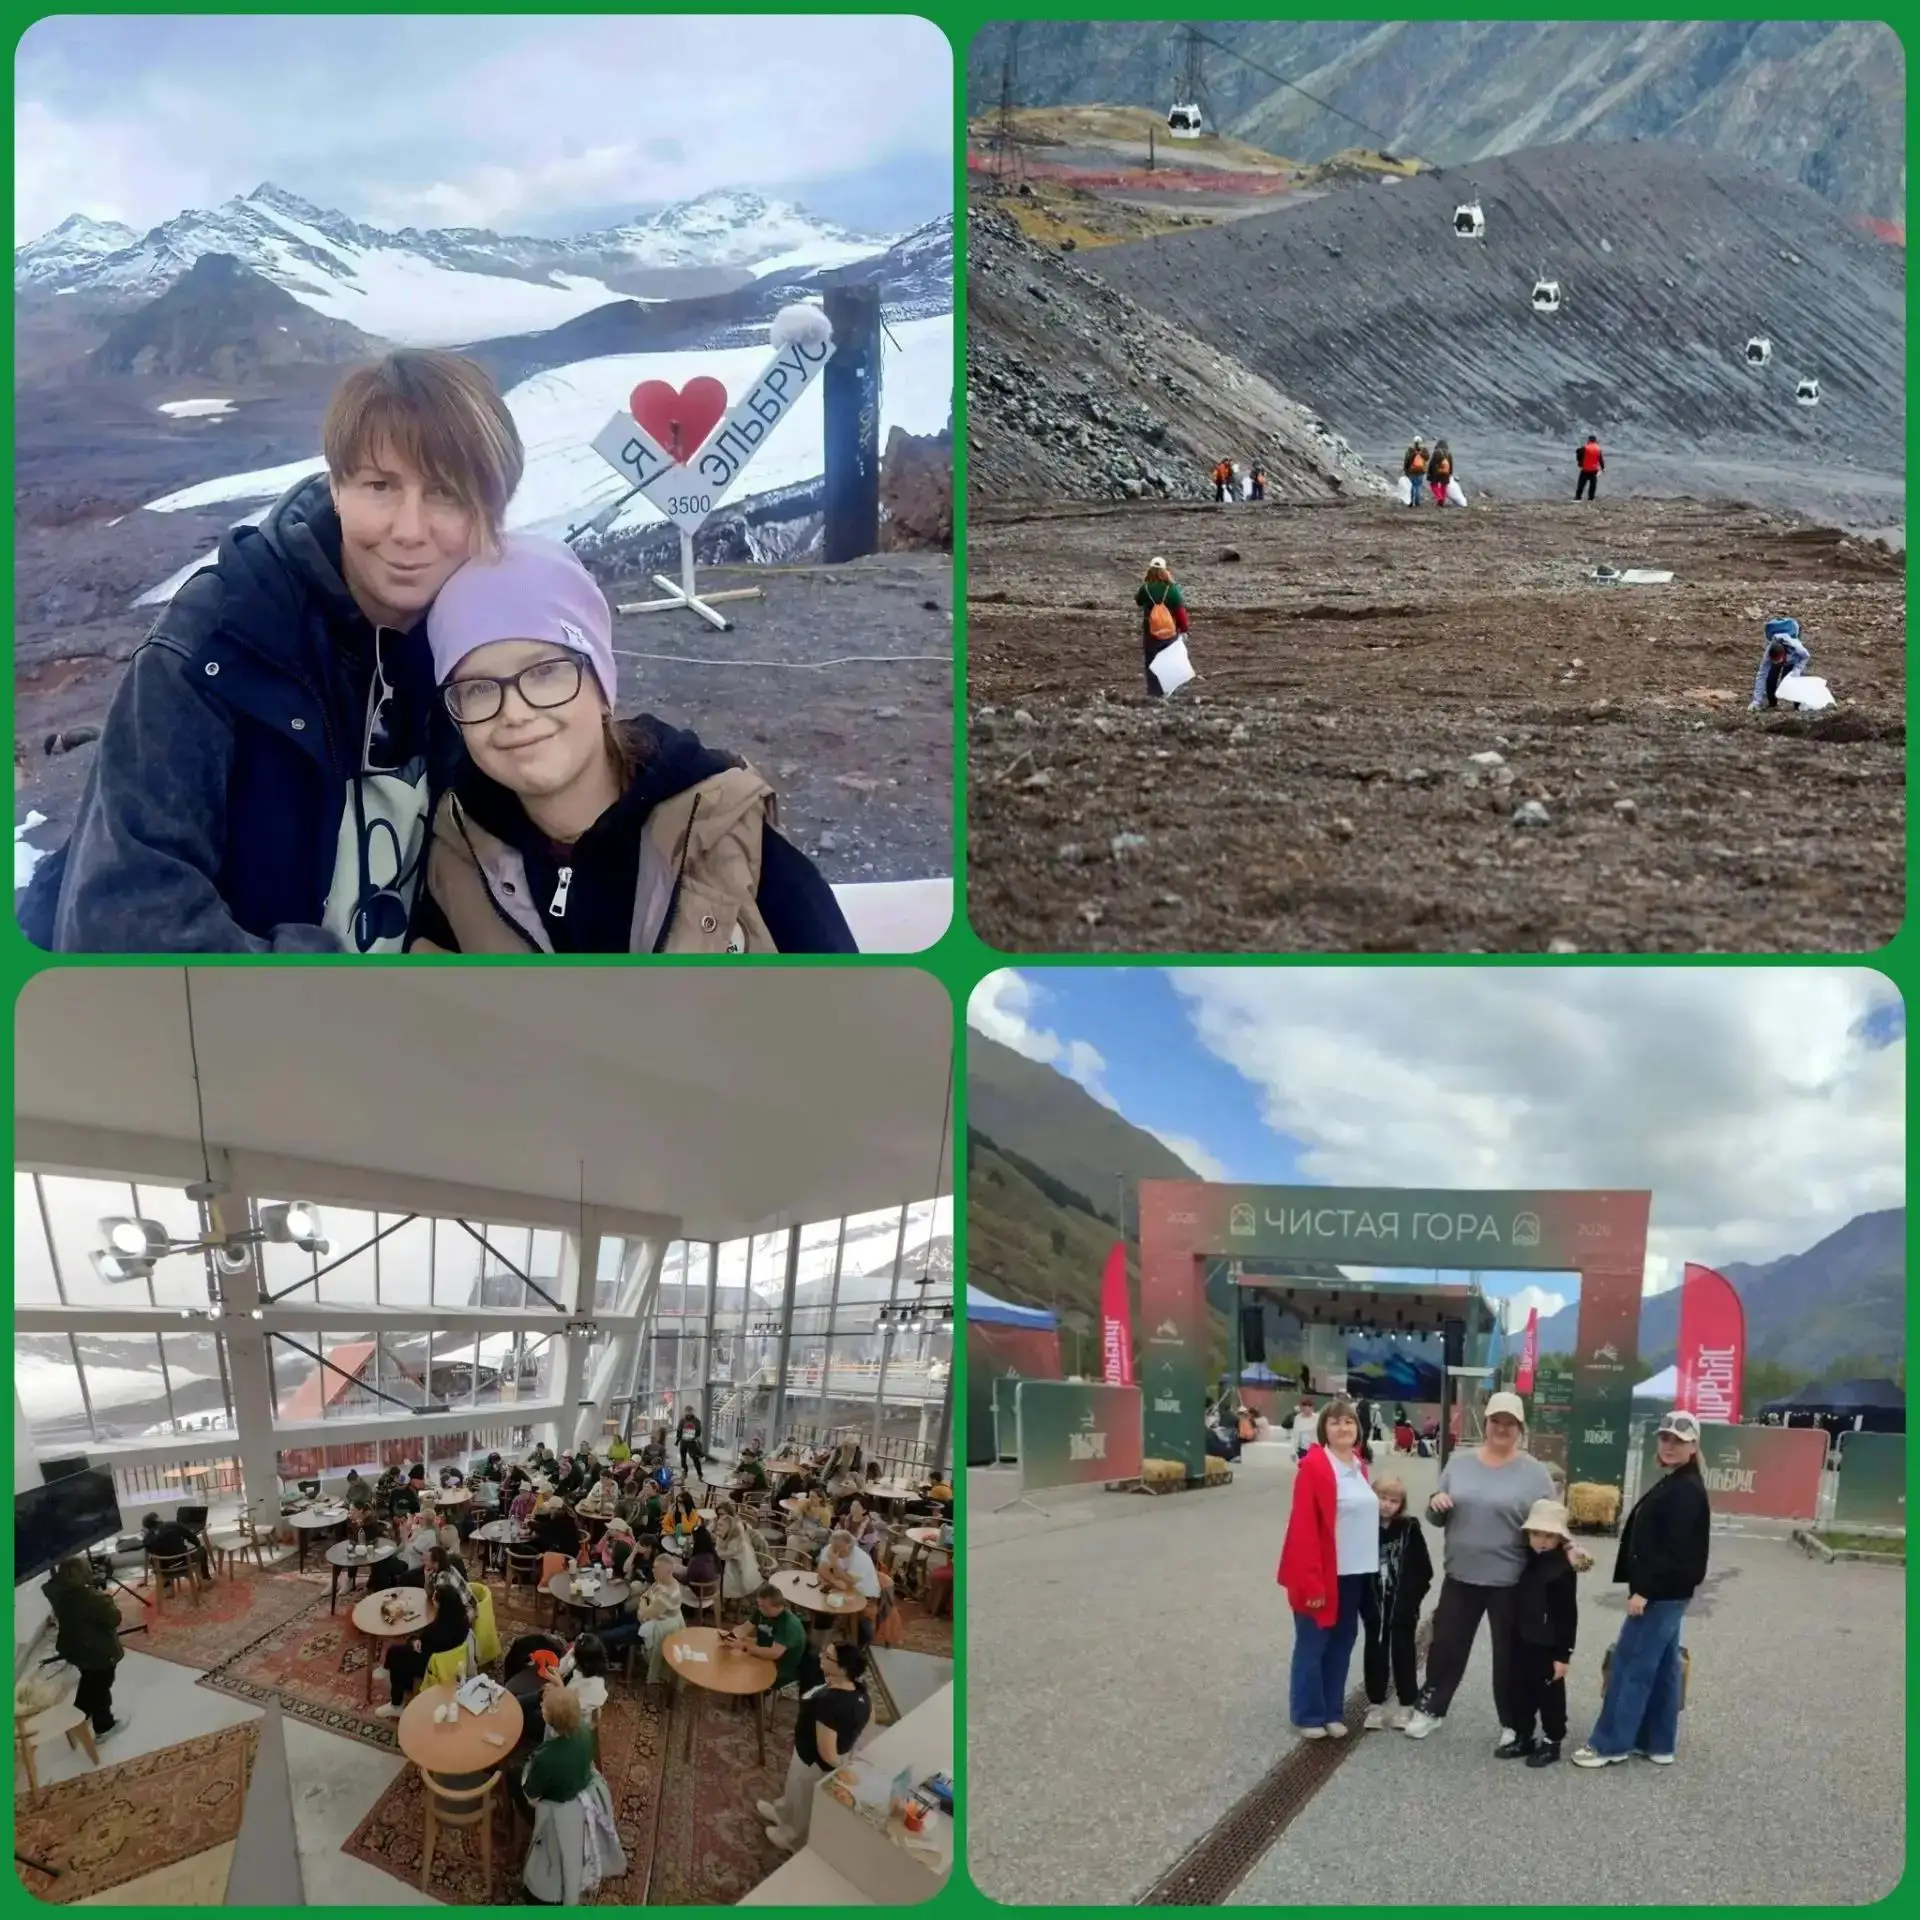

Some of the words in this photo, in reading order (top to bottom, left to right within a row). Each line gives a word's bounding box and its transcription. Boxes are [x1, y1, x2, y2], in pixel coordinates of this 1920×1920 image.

[699, 341, 828, 488] ЭЛЬБРУС
[620, 437, 658, 480] Я
[667, 495, 711, 515] 3500
[1264, 1207, 1400, 1240] ЧИСТАЯ
[1412, 1211, 1501, 1242] ГОРА
[1104, 1315, 1121, 1386] ЛЬБРУС
